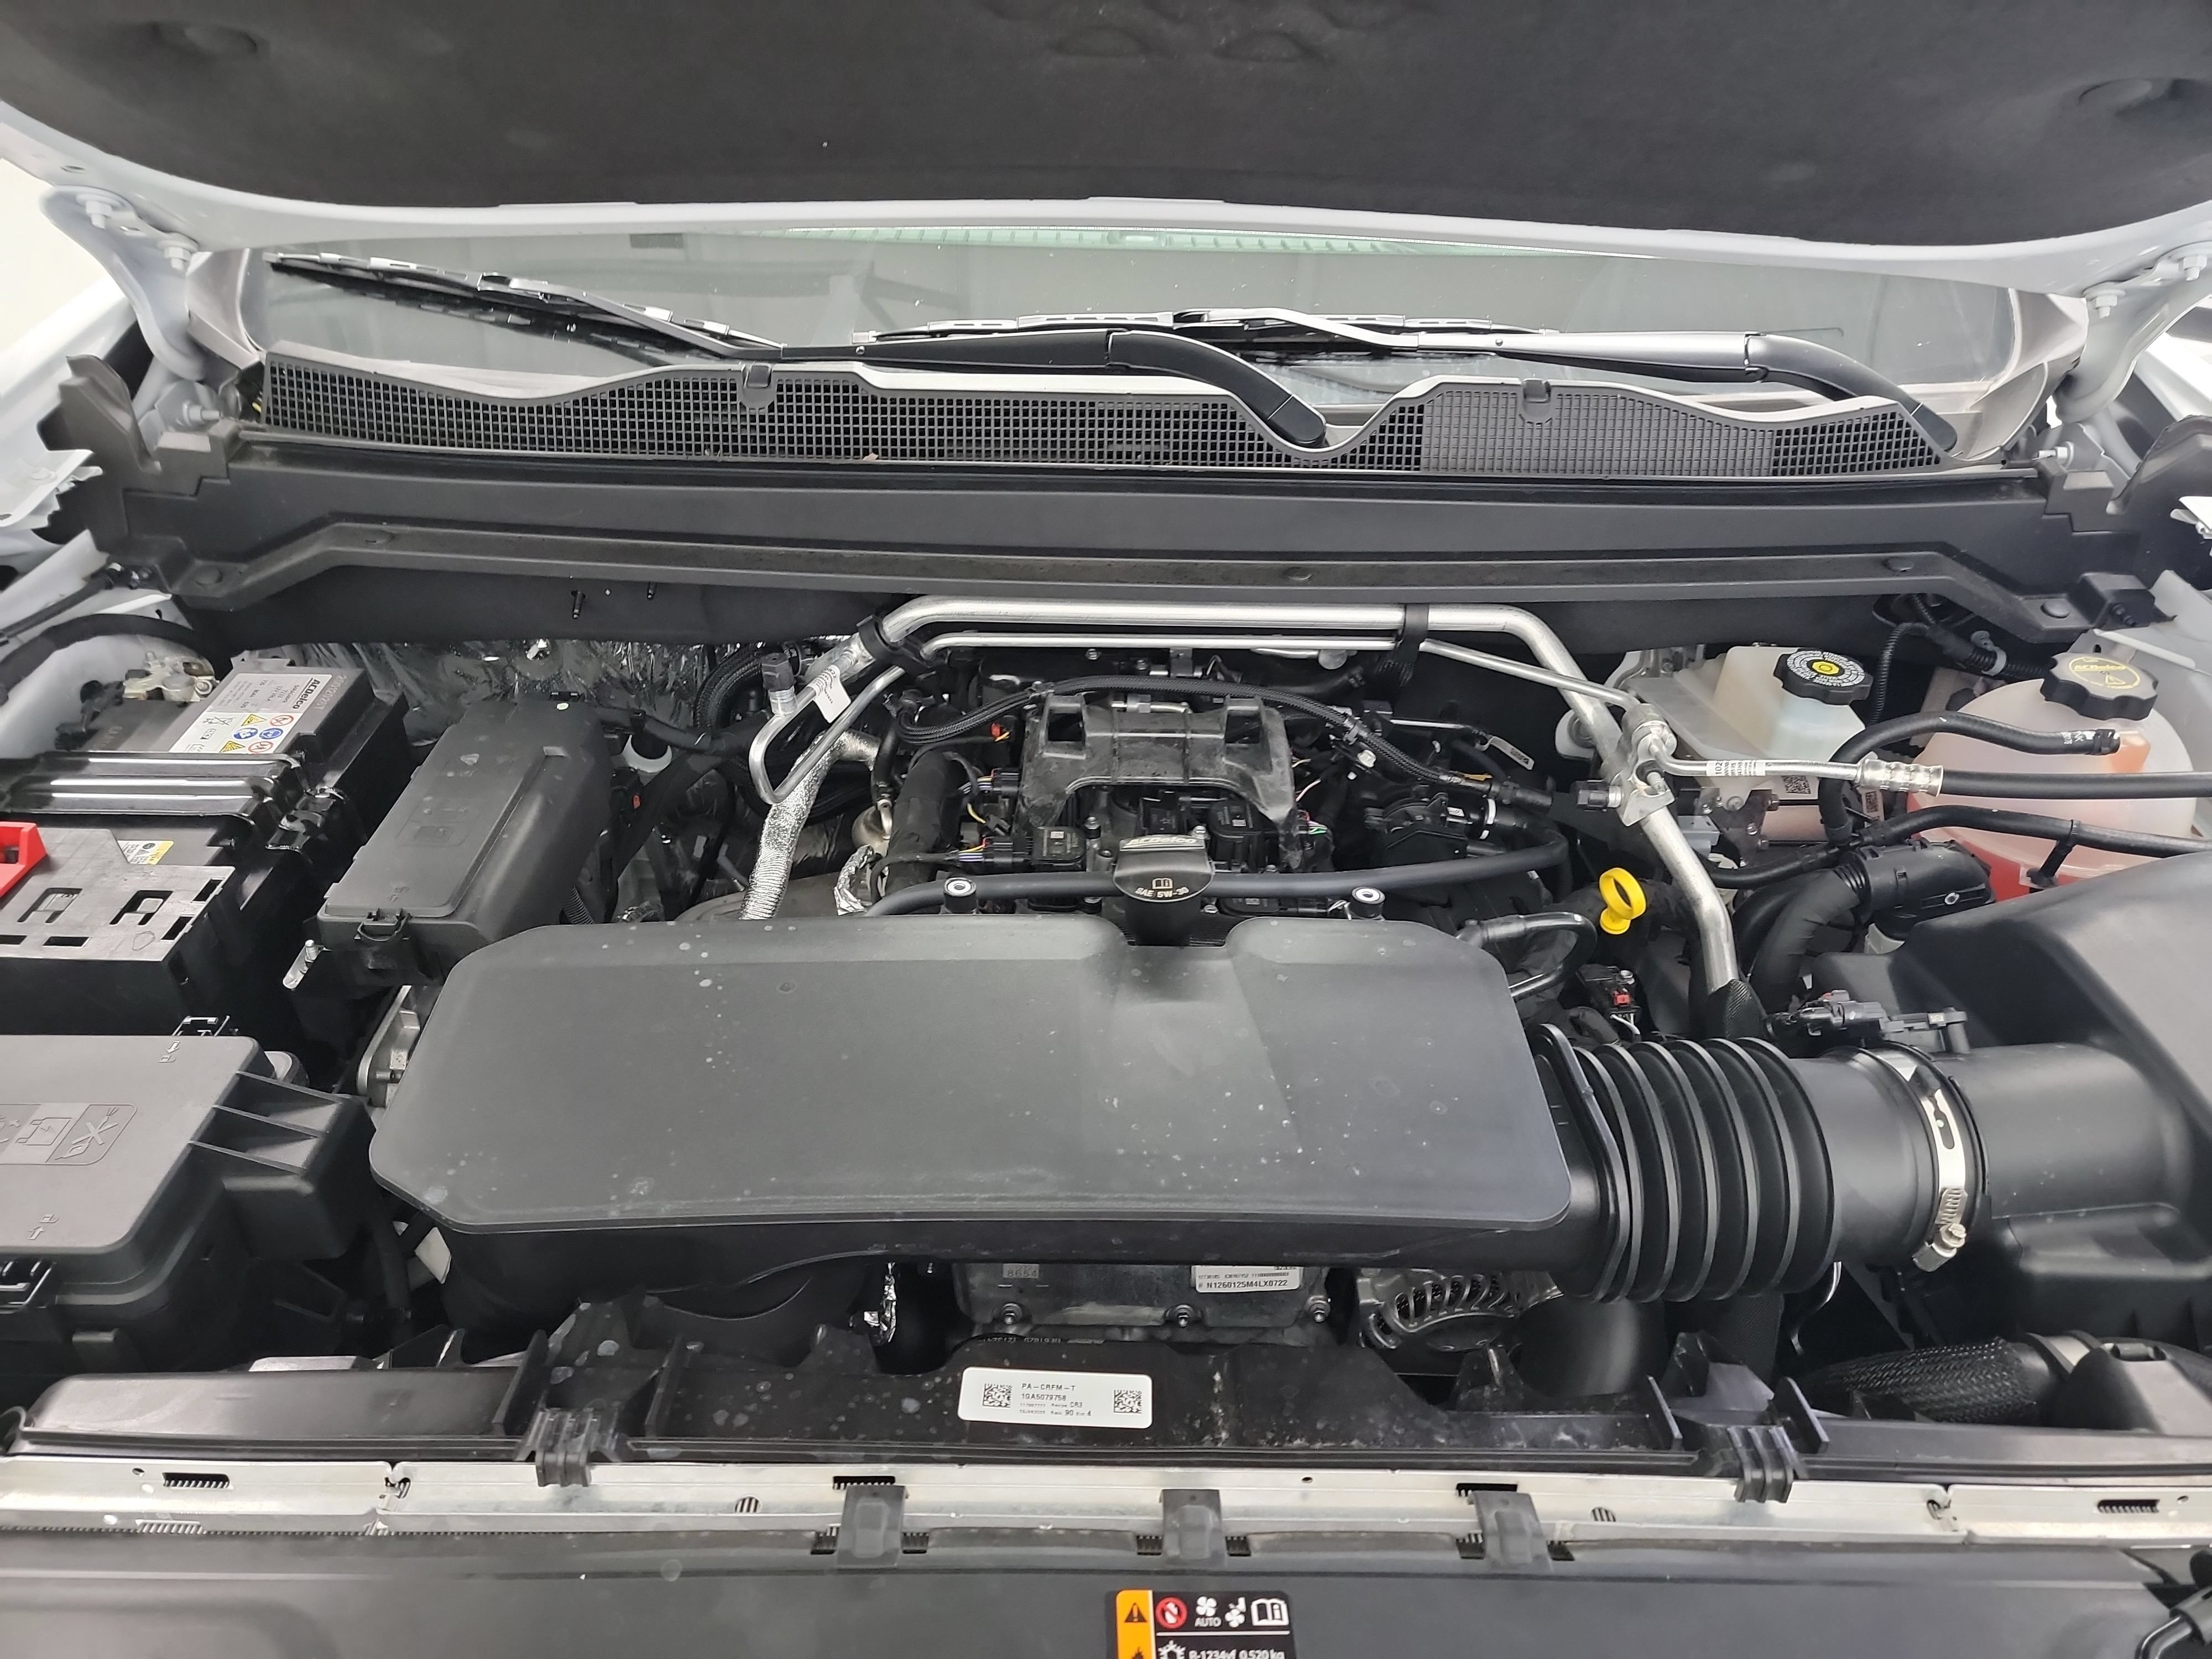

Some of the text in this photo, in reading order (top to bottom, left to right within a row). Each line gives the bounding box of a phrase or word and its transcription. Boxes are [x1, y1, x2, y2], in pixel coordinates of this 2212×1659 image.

[292, 679, 321, 709] ACDelco
[1126, 837, 1197, 846] ACDelco
[1135, 886, 1190, 899] SAE 5W-30
[1194, 1616, 1222, 1627] AUTO
